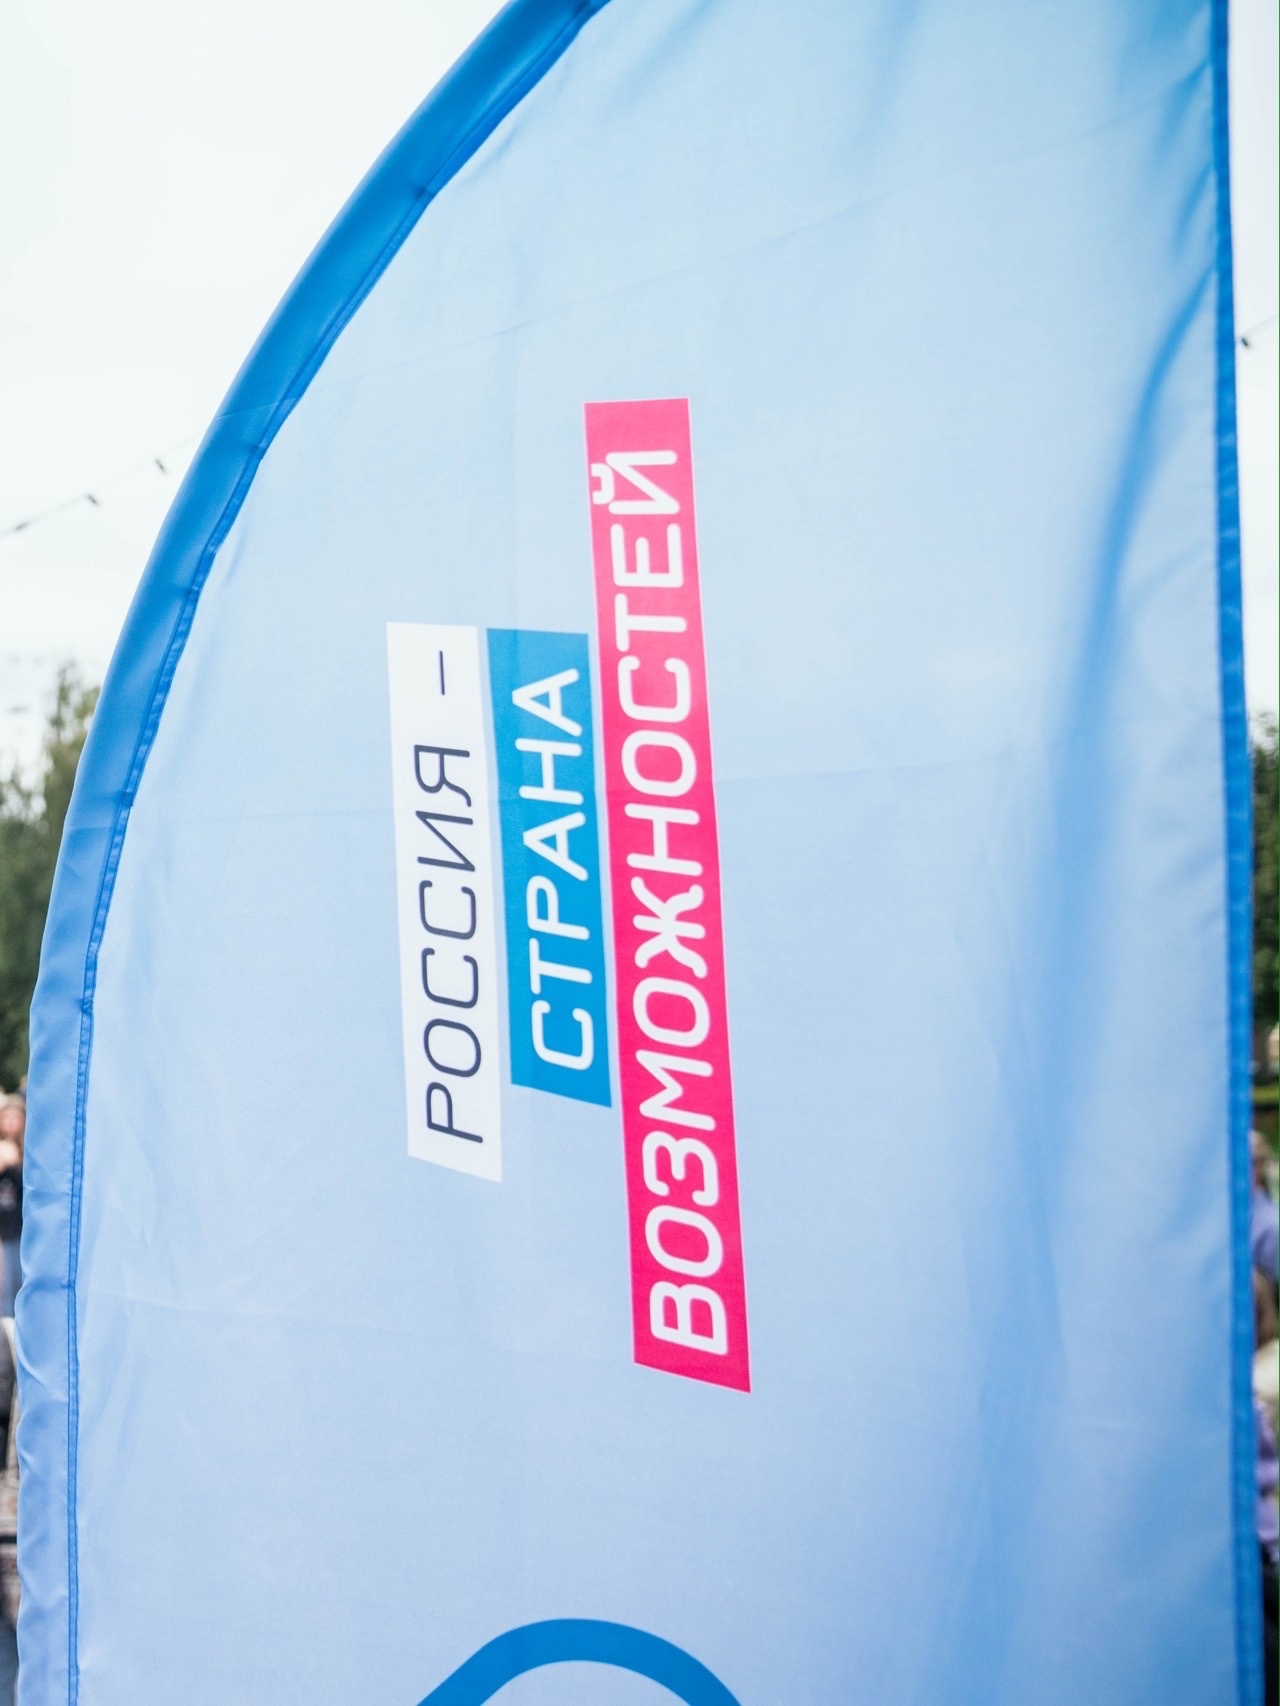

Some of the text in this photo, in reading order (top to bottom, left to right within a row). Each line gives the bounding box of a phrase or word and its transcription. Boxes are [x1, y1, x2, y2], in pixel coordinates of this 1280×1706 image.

[413, 744, 483, 1143] РОССИЯ
[511, 668, 593, 1071] СТРАНА
[592, 451, 728, 1355] ВОЗМОЖНОСТЕЙ
